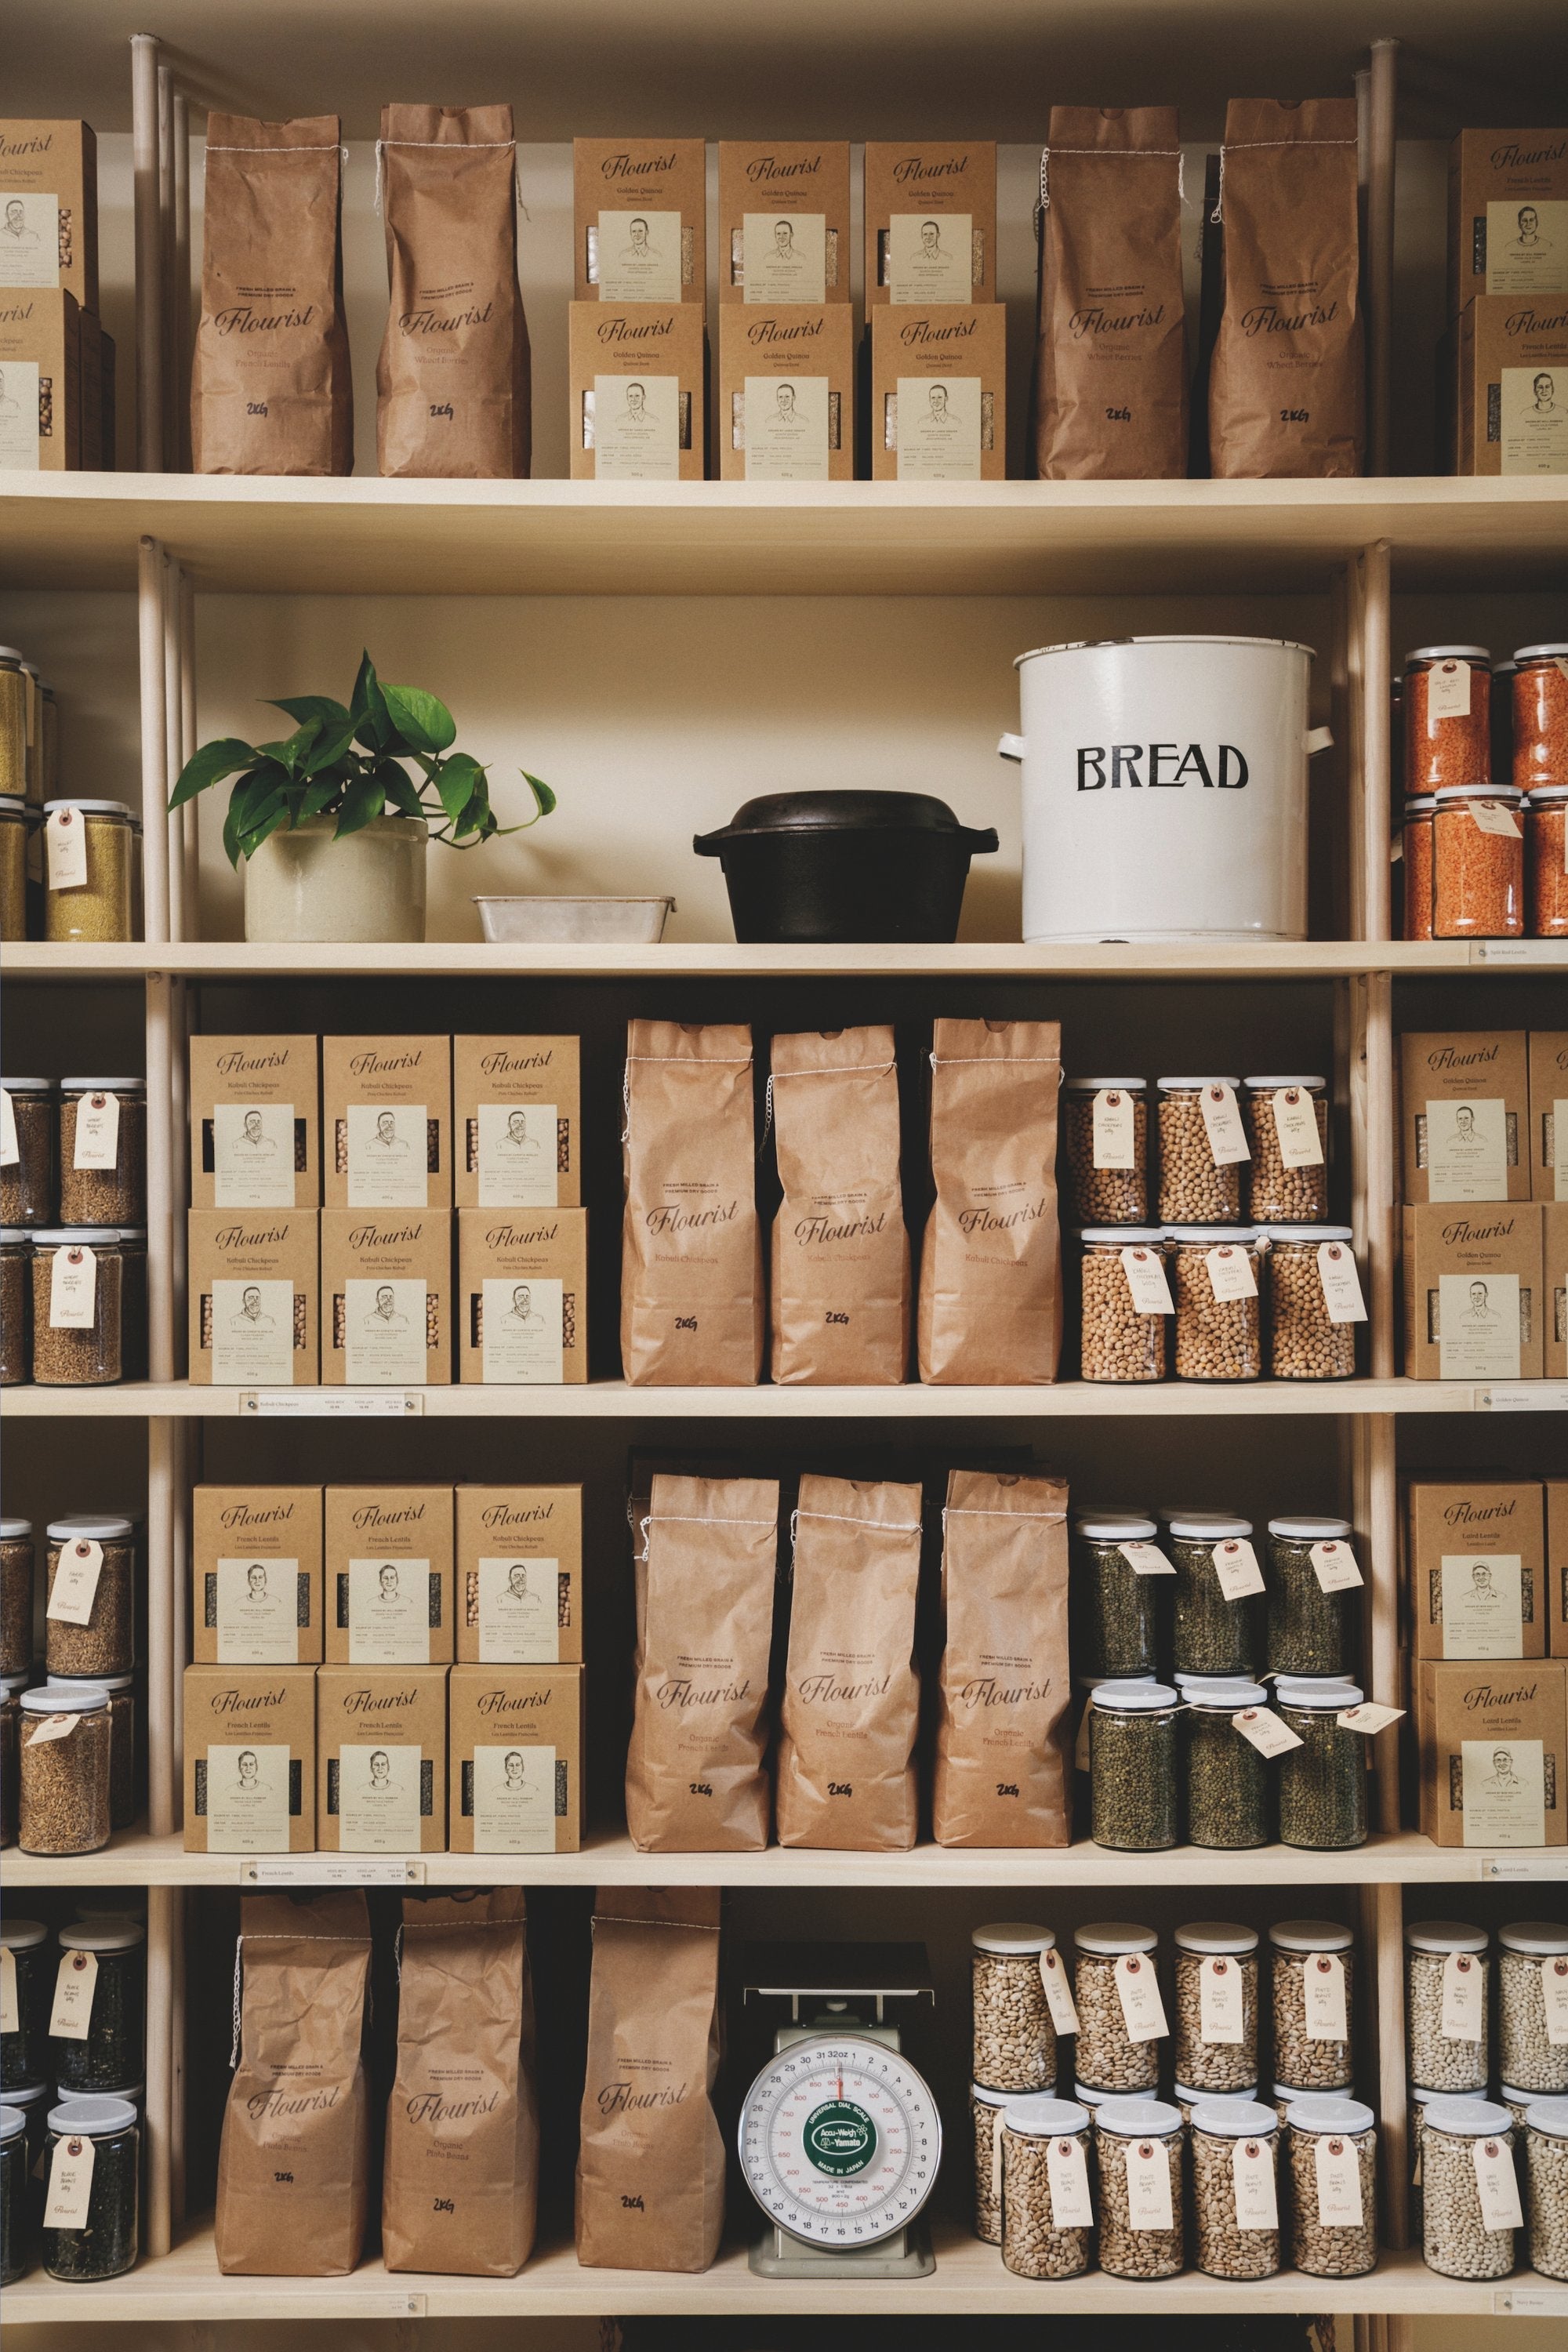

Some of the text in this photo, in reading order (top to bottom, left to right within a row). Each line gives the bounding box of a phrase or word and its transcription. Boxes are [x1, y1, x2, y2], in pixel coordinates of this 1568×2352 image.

[601, 154, 677, 180] Flourist
[1490, 142, 1566, 170] Flourist
[746, 156, 822, 182] Flourist
[893, 156, 968, 183] Flourist
[214, 306, 314, 336] Flourist
[398, 302, 493, 337] Flourist
[597, 318, 674, 343] Flourist
[1069, 305, 1166, 339] Flourist
[1241, 301, 1339, 336] Flourist
[1505, 310, 1568, 336] Flouri
[748, 318, 824, 345] Flourist
[901, 319, 977, 346] Flourist
[247, 402, 268, 418] 2KG
[430, 403, 454, 421] 2KG
[1105, 406, 1131, 423] 2KG
[1280, 408, 1309, 423] 2KG
[1077, 744, 1249, 791] BREAD
[216, 1050, 289, 1075] Flourist
[350, 1051, 422, 1076] Flourist
[481, 1051, 552, 1075] Flourist
[1428, 1045, 1498, 1071] Flourist
[646, 1201, 739, 1236] Flourist
[959, 1198, 1047, 1233] Flourist
[216, 1225, 289, 1250] Flourist
[349, 1224, 423, 1249] Flourist
[486, 1224, 558, 1249] Flourist
[794, 1213, 887, 1246] Flourist
[1443, 1219, 1515, 1245] Flourist
[675, 1316, 698, 1331] 2KG
[826, 1312, 849, 1325] 2KG
[221, 1503, 294, 1529] Flourist
[353, 1504, 426, 1529] Flourist
[482, 1503, 554, 1528] Flourist
[1444, 1500, 1516, 1526] Flourist
[212, 1689, 285, 1714] Flourist
[657, 1680, 750, 1709] Flourist
[799, 1674, 892, 1704] Flourist
[962, 1679, 1052, 1709] Flourist
[1464, 1684, 1537, 1710] Flourist
[343, 1690, 418, 1714] Flourist
[477, 1690, 551, 1715] Flourist
[689, 1784, 713, 1797] 2KG
[827, 1783, 852, 1798] 2KG
[996, 1784, 1019, 1798] 2KG
[247, 2086, 339, 2120] Flourist
[407, 2091, 500, 2124] Flourist
[597, 2082, 687, 2114] Flourist
[809, 2103, 837, 2124] UNIVERSAL
[853, 2107, 870, 2123] SCALE
[274, 2172, 294, 2183] 2KG
[817, 2161, 835, 2173] MADE
[845, 2160, 864, 2173] JAPAN
[434, 2198, 454, 2214] 2KG
[621, 2195, 644, 2212] 2KG
